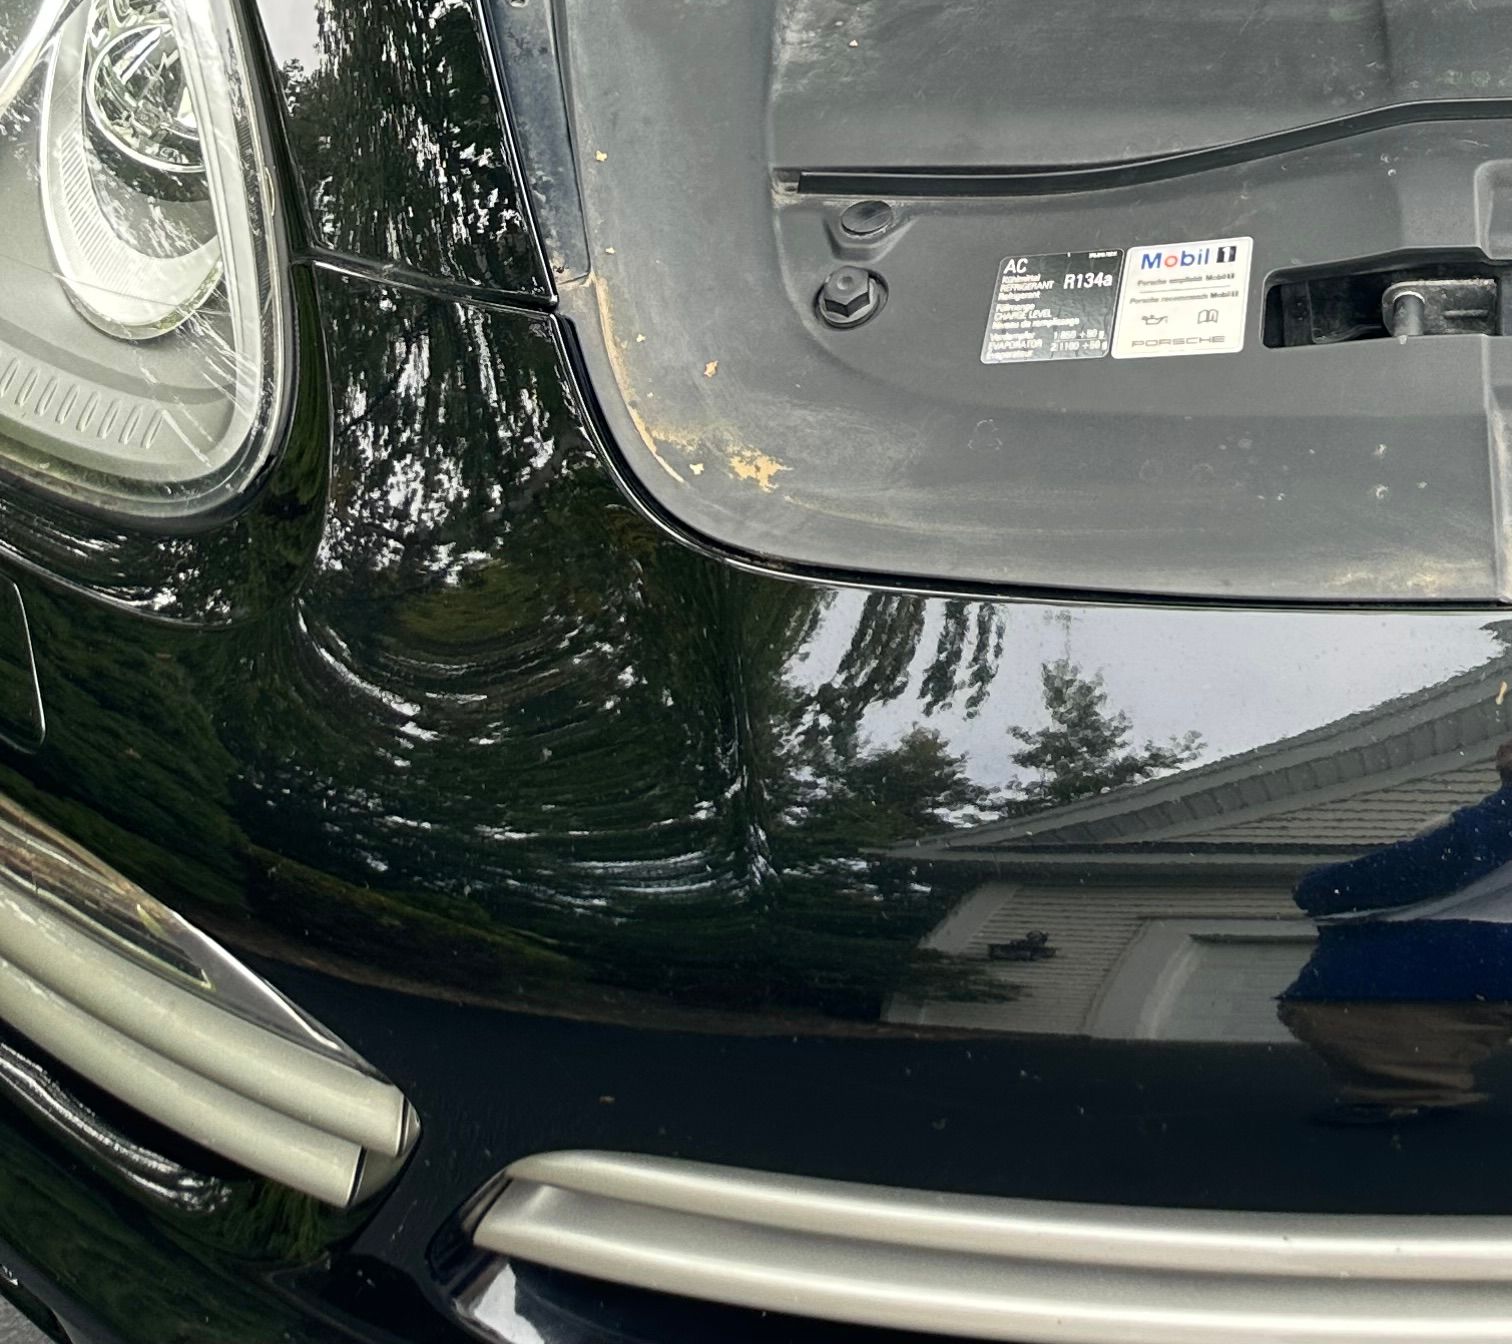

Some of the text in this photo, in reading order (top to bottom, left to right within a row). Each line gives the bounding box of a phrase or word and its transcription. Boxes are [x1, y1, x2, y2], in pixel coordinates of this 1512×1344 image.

[1141, 245, 1237, 270] Mobil 1
[1003, 258, 1028, 274] AC
[1063, 271, 1113, 290] R134a
[1028, 309, 1052, 319] LEVEL
[1131, 335, 1226, 348] PORSCHE
